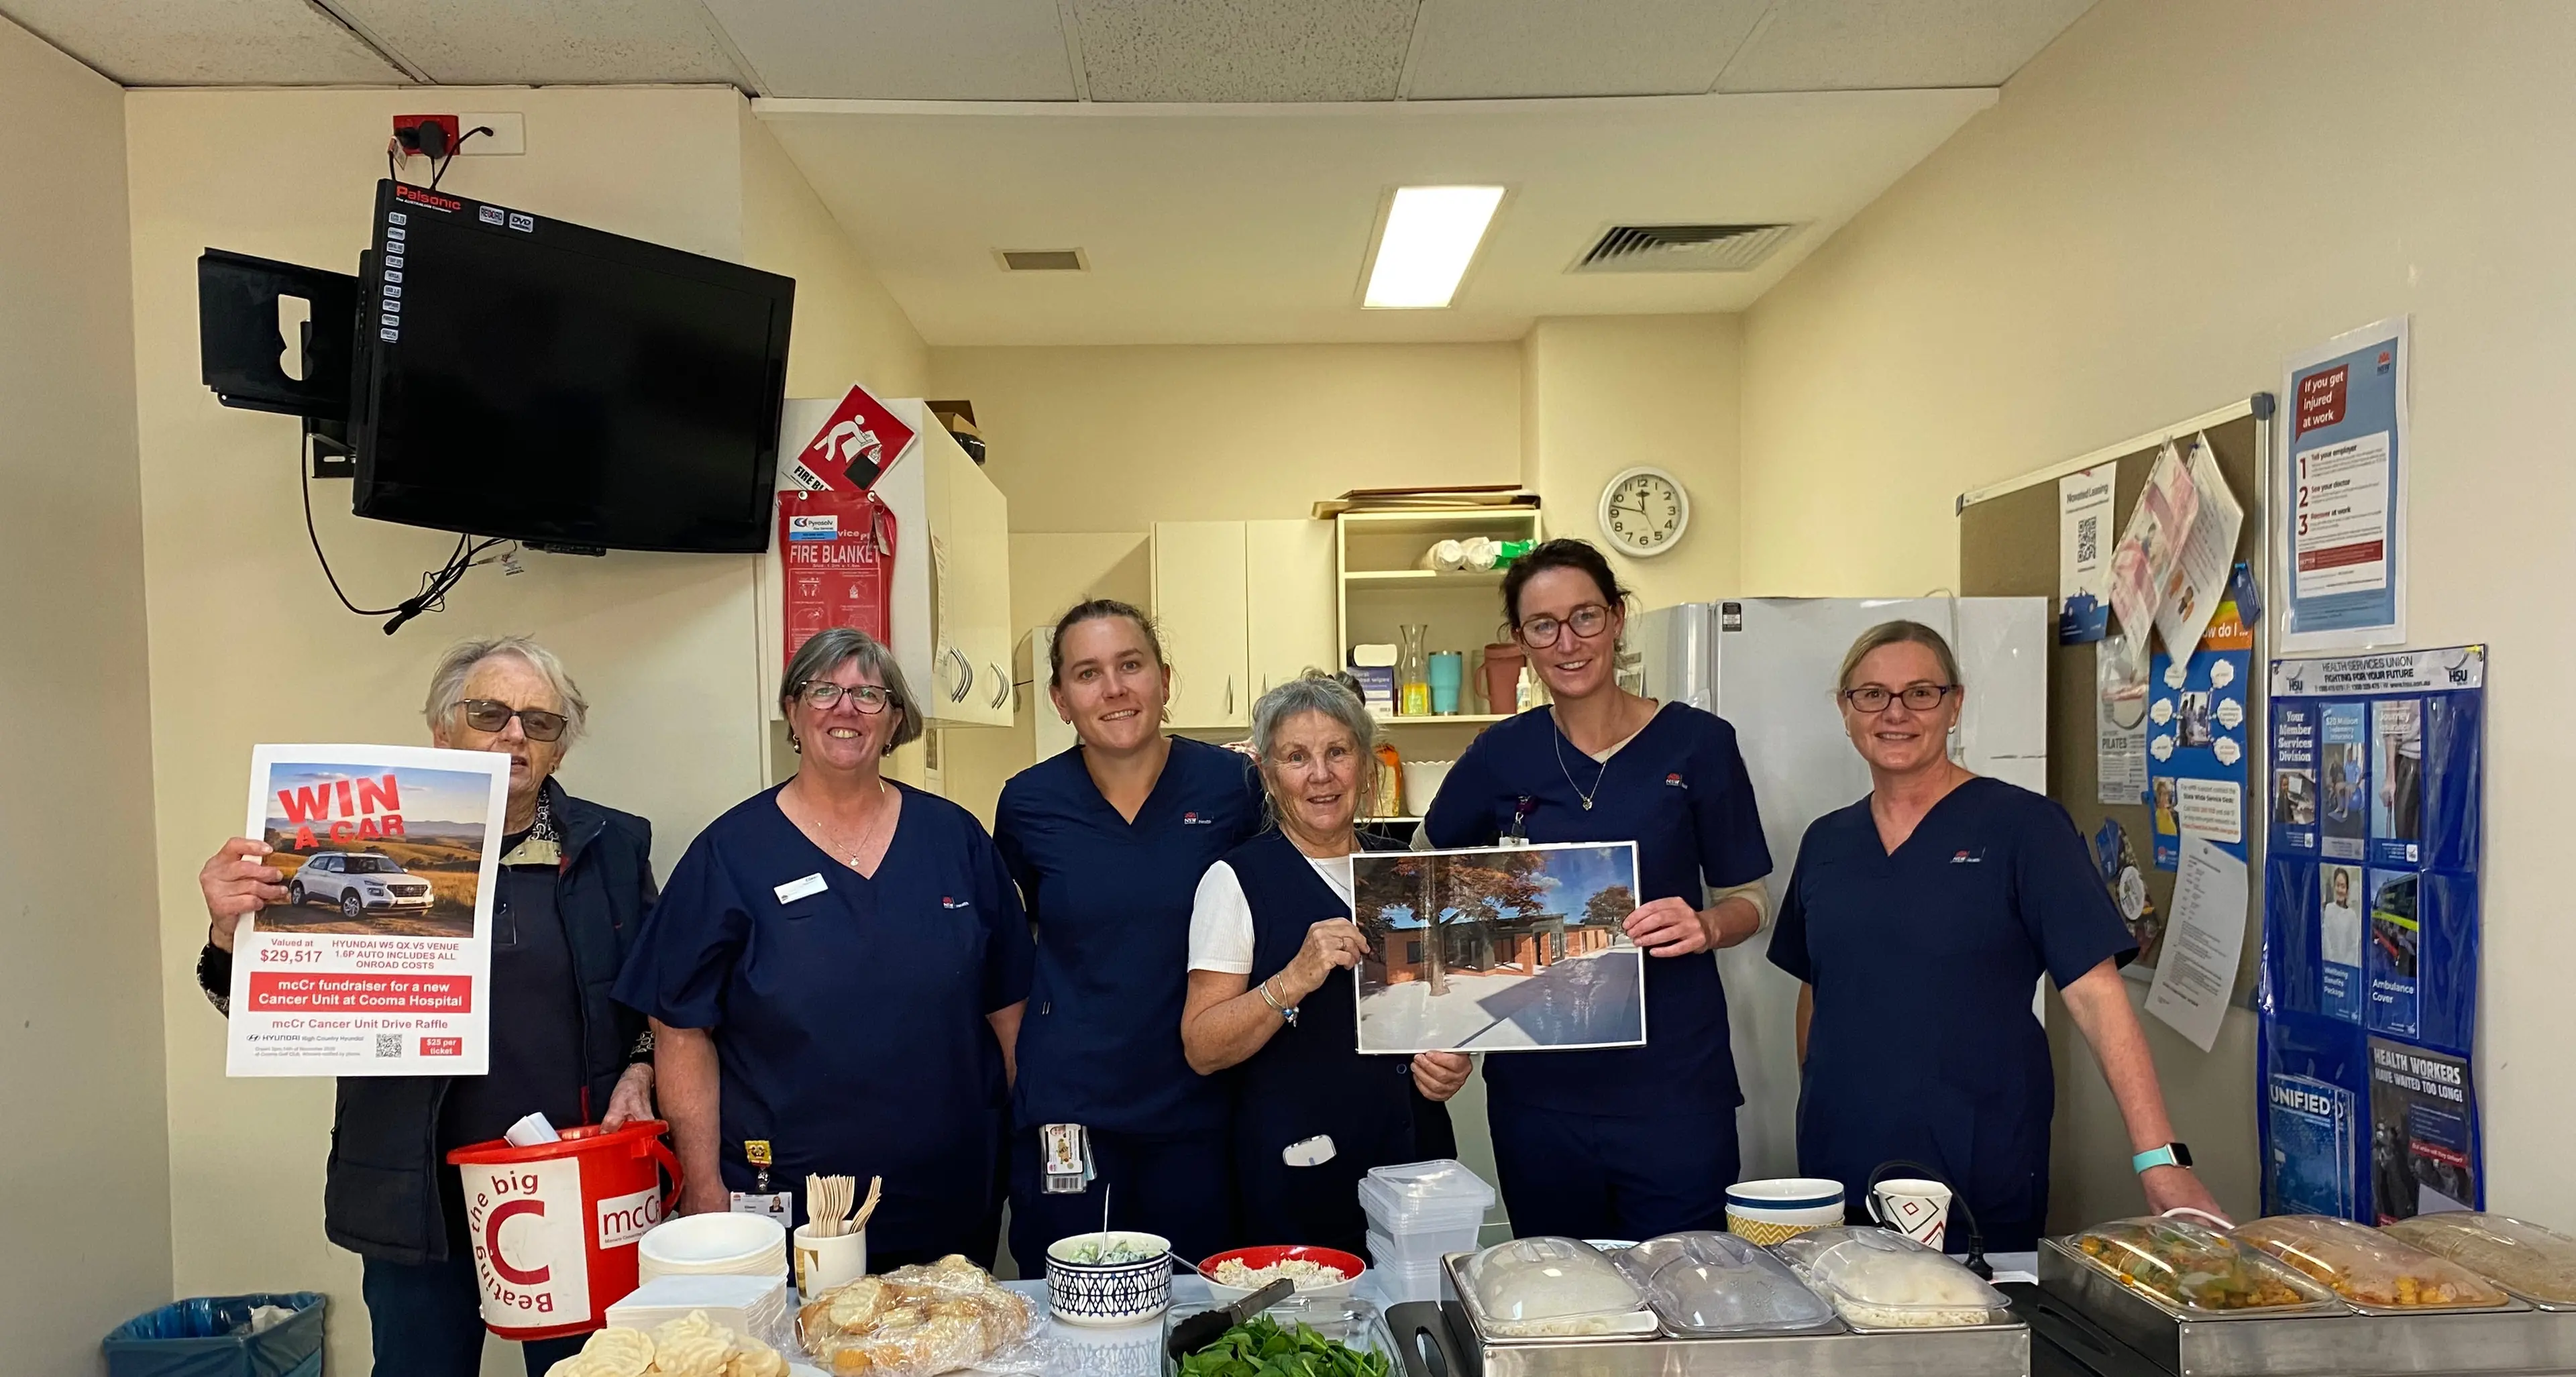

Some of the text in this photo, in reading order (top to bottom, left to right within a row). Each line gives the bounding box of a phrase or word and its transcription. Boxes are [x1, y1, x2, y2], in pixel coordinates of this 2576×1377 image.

[396, 185, 462, 211] Palsonic
[481, 208, 502, 221] RECORD
[512, 216, 531, 226] DVD
[2304, 370, 2344, 393] If you get
[2303, 391, 2332, 412] injured
[2302, 409, 2334, 428] at work
[2300, 457, 2306, 480] 1
[2320, 450, 2332, 461] your
[2332, 445, 2357, 457] employer
[794, 465, 814, 485] FIRE
[1625, 483, 1632, 492] 11
[1637, 479, 1648, 488] 12
[1613, 494, 1624, 502] 10
[1664, 491, 1672, 500] 2
[2299, 486, 2309, 508] 2
[2321, 482, 2332, 494] your
[2333, 479, 2351, 488] doctor
[1610, 509, 1619, 518] 9
[1668, 506, 1676, 516] 3
[1614, 522, 1623, 532] 8
[1664, 520, 1672, 529] 4
[2298, 514, 2308, 536] 3
[2338, 506, 2351, 514] work
[1625, 532, 1633, 542] 7
[1640, 536, 1648, 545] 6
[1654, 531, 1662, 541] 5
[790, 545, 879, 563] FIRE BLANKET
[2218, 622, 2231, 637] do
[2234, 624, 2238, 637] I
[2322, 656, 2413, 672] HEALTH SERVICES UNION
[2324, 673, 2352, 683] FIGHTING
[2367, 671, 2385, 680] YOUR
[2385, 668, 2414, 679] FUTURE
[2449, 669, 2467, 683] HSU
[2289, 680, 2303, 692] HSU
[2286, 711, 2304, 722] Your
[2381, 712, 2410, 723] Journey
[2279, 723, 2312, 735] Member
[2102, 738, 2127, 749] PILATES
[2278, 736, 2312, 749] Services
[2279, 751, 2311, 762] Division
[277, 774, 400, 824] WIN
[294, 814, 405, 850] A CAR
[271, 939, 302, 947] Valued
[332, 940, 377, 948] HYUNDAI
[379, 941, 394, 949] W5
[427, 942, 459, 951] VENUE
[260, 948, 322, 965] $29,517
[335, 950, 456, 960] 1.6P AUTO INCLUDES ALL
[356, 960, 399, 969] ONROAD
[278, 979, 451, 993] mcCr fundraiser for a new
[2324, 986, 2345, 998] Package
[2372, 979, 2414, 994] Ambulance
[258, 993, 462, 1008] Cancer Unit at Cooma Hospital
[2372, 991, 2394, 1003] Cover
[272, 1019, 448, 1029] mcCr Cancer Unit Drive Raffle
[427, 1038, 457, 1048] $25 per
[2373, 1048, 2461, 1085] HEALTH WORKERS
[2375, 1068, 2463, 1103] HAVE WAITED TOO LONG!
[2270, 1084, 2330, 1115] UNIFIED
[491, 1170, 538, 1195] big
[471, 1193, 488, 1233] the
[486, 1199, 551, 1285] C
[476, 1246, 554, 1313] Beating
